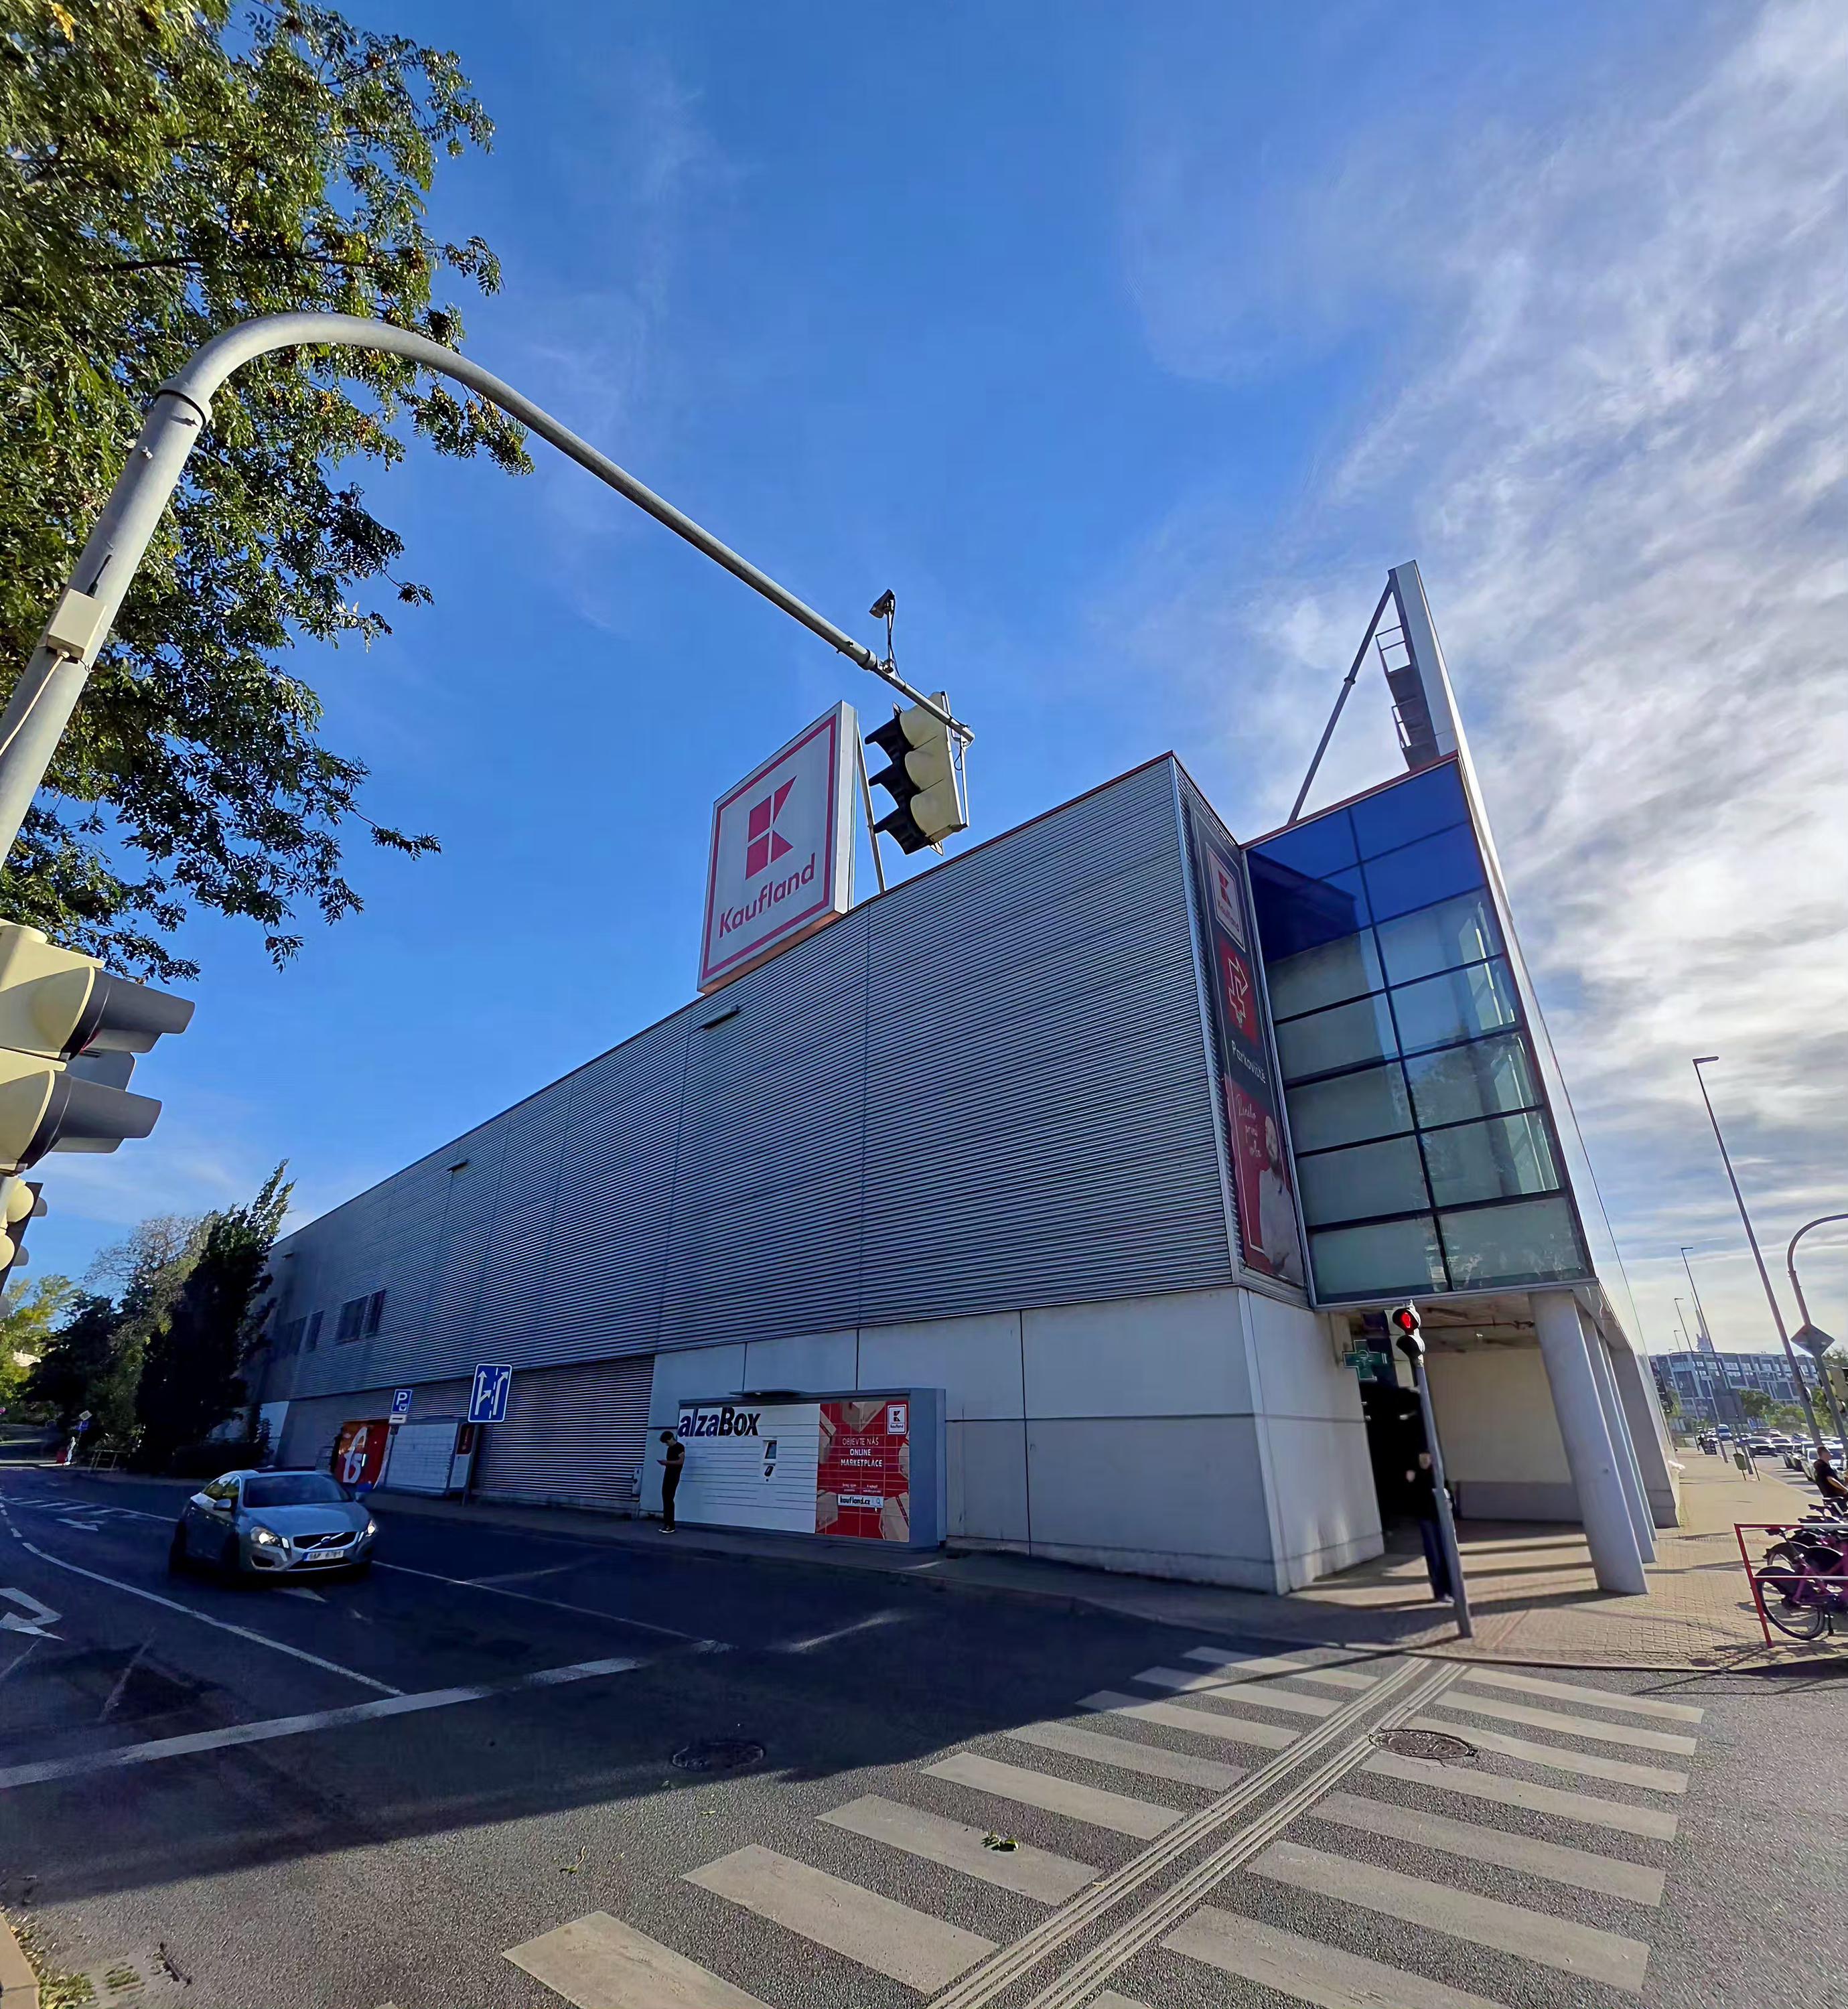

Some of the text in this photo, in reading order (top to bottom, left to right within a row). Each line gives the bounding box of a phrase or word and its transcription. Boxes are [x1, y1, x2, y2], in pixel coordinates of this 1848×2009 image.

[719, 852, 815, 939] Kaufland
[397, 1392, 408, 1406] P
[678, 1406, 762, 1437] alzaBox
[842, 1437, 879, 1446] OBJEVTE NÁŠ
[841, 1459, 883, 1467] MARKETPLACE
